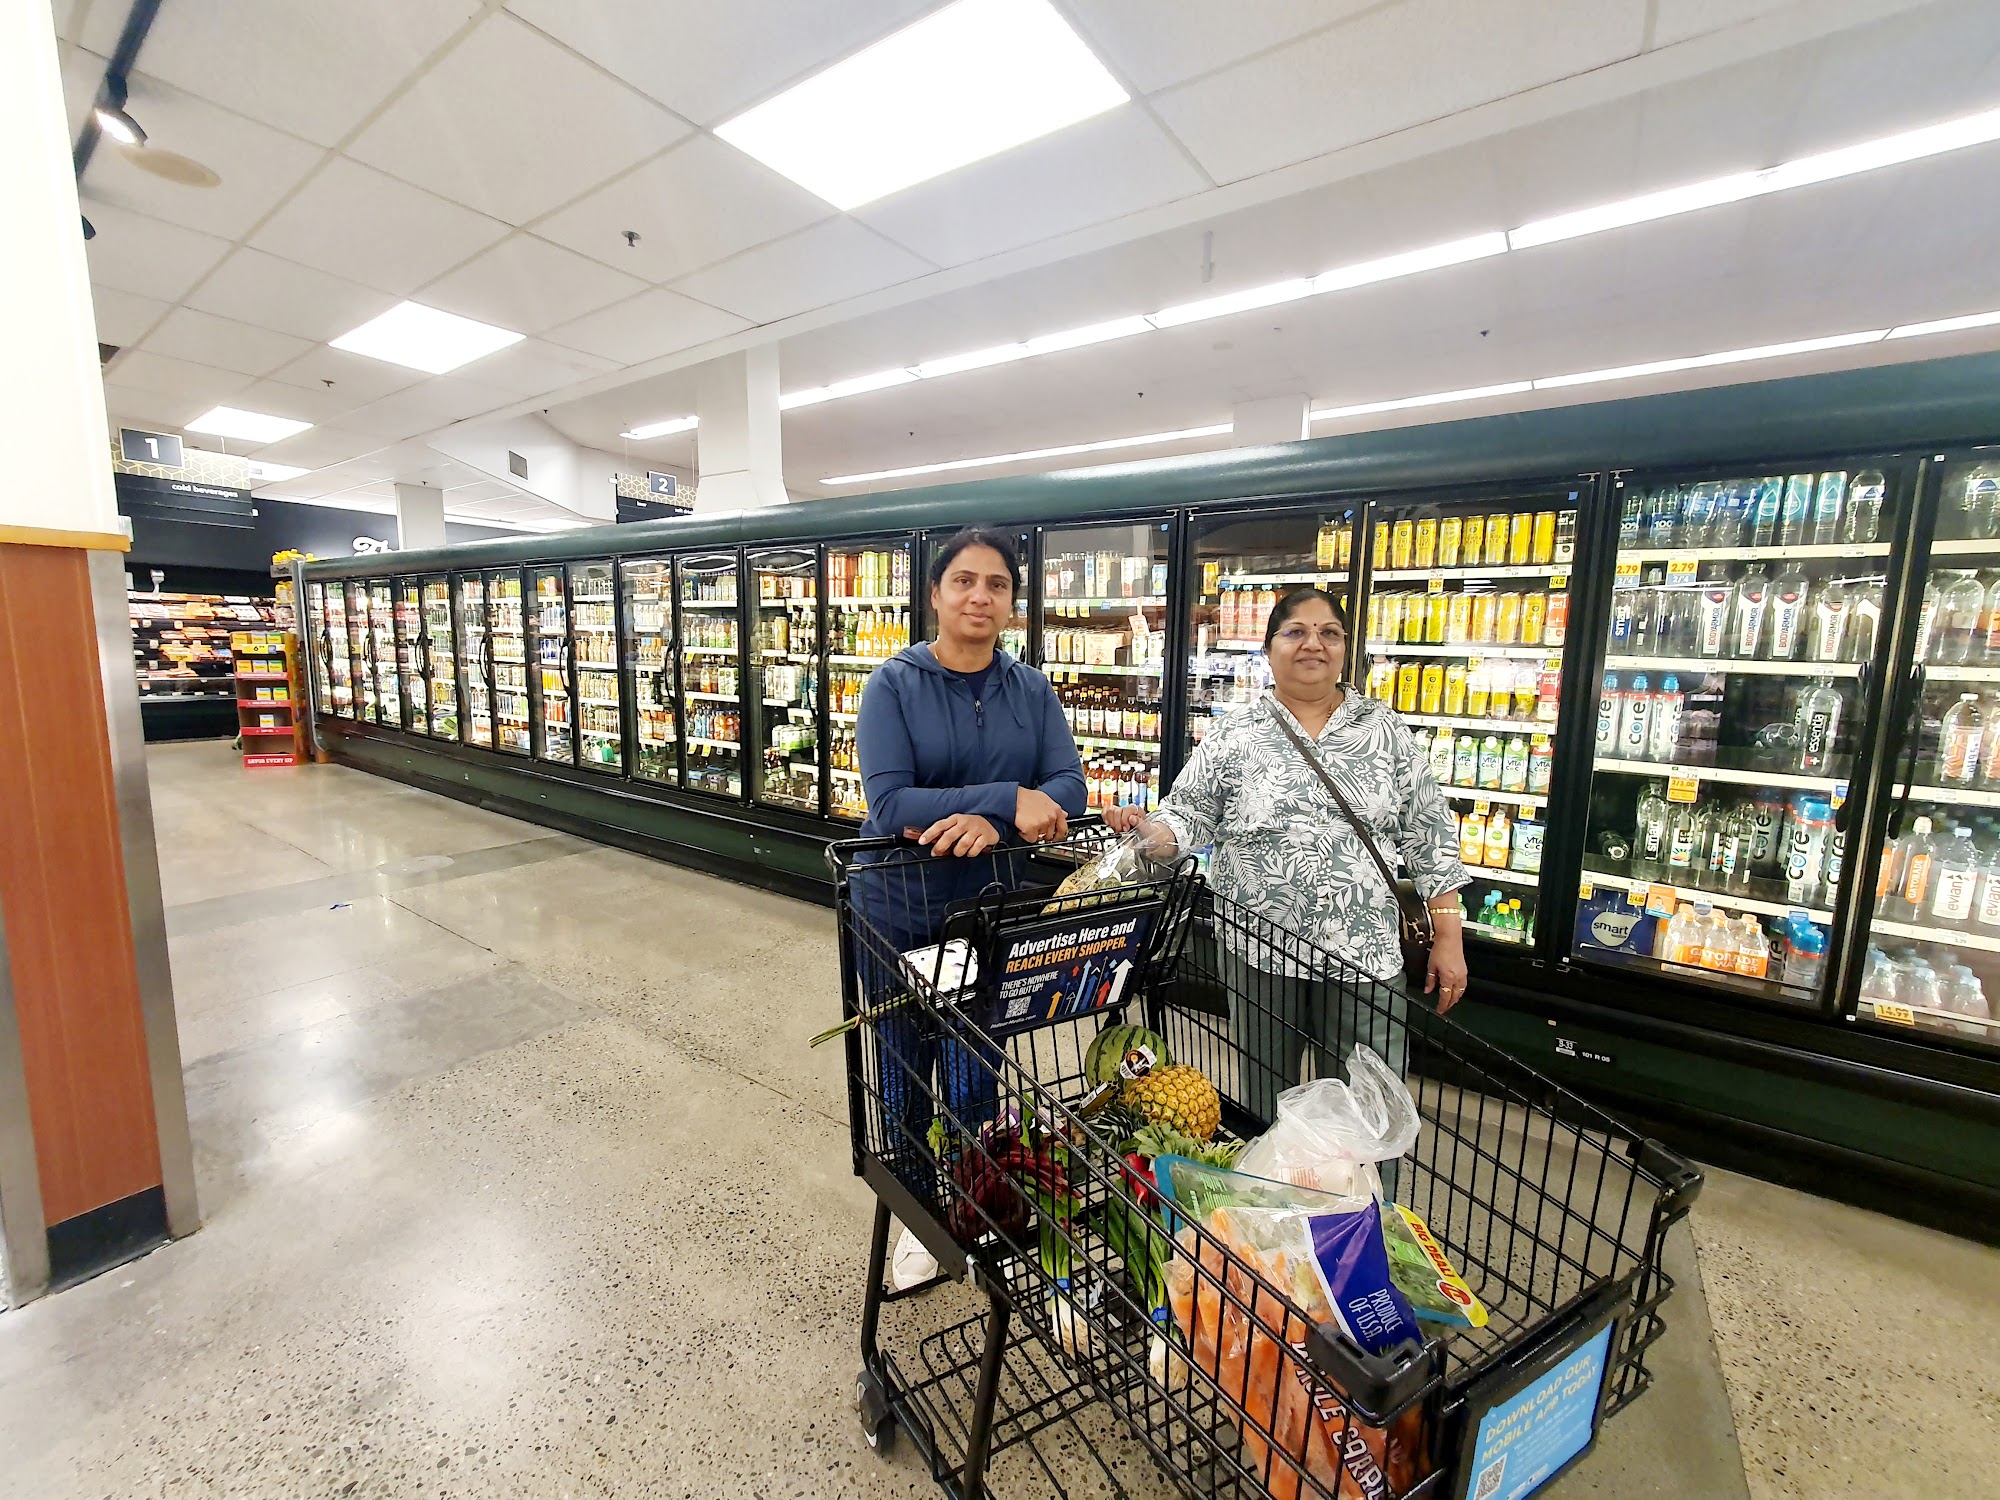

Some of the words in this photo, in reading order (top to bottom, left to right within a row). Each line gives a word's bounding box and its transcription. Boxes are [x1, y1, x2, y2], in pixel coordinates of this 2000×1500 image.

[144, 438, 159, 459] 1
[171, 483, 192, 492] cold
[192, 486, 239, 498] beverages
[658, 477, 669, 492] 2
[1617, 565, 1638, 574] 2.79
[1671, 563, 1694, 572] 2.79
[1708, 607, 1721, 646] BODYARMOR
[1745, 607, 1760, 647] BODYARMOR
[1779, 608, 1792, 648] BODYARMOR
[1825, 614, 1839, 653] BODYARMOR
[1629, 701, 1646, 744] core
[1808, 714, 1825, 753] essentia
[1789, 830, 1809, 880] core
[1908, 859, 1922, 898] GATORADE
[1948, 880, 1963, 911] evian
[1008, 932, 1077, 959] Advertise
[1078, 925, 1108, 946] Here
[1111, 917, 1137, 935] and
[1593, 921, 1629, 935] smart
[1005, 954, 1044, 974] REACH
[1044, 946, 1078, 964] EVERY
[1078, 936, 1127, 957] SHOPPER.
[1690, 947, 1758, 967] GATORADE
[1714, 959, 1758, 973] WATER
[999, 990, 1009, 1000] TO
[1008, 989, 1018, 998] GO
[1018, 985, 1032, 996] BUT
[1032, 982, 1044, 993] UP!
[1001, 977, 1028, 991] THERE'S
[1027, 970, 1059, 985] NOWHERE
[1582, 1051, 1593, 1059] 101
[1410, 1222, 1430, 1242] BIG
[1424, 1243, 1456, 1279] DEAL!
[1349, 1297, 1364, 1315] OF
[1357, 1307, 1383, 1342] U.S.A.
[1368, 1288, 1404, 1335] PRODUCE
[1481, 1419, 1533, 1464] MOBILE
[1535, 1395, 1560, 1422] APP
[1561, 1361, 1599, 1399] TODAY
[1485, 1376, 1563, 1444] DOWNLOAD
[1564, 1354, 1592, 1381] OUR
